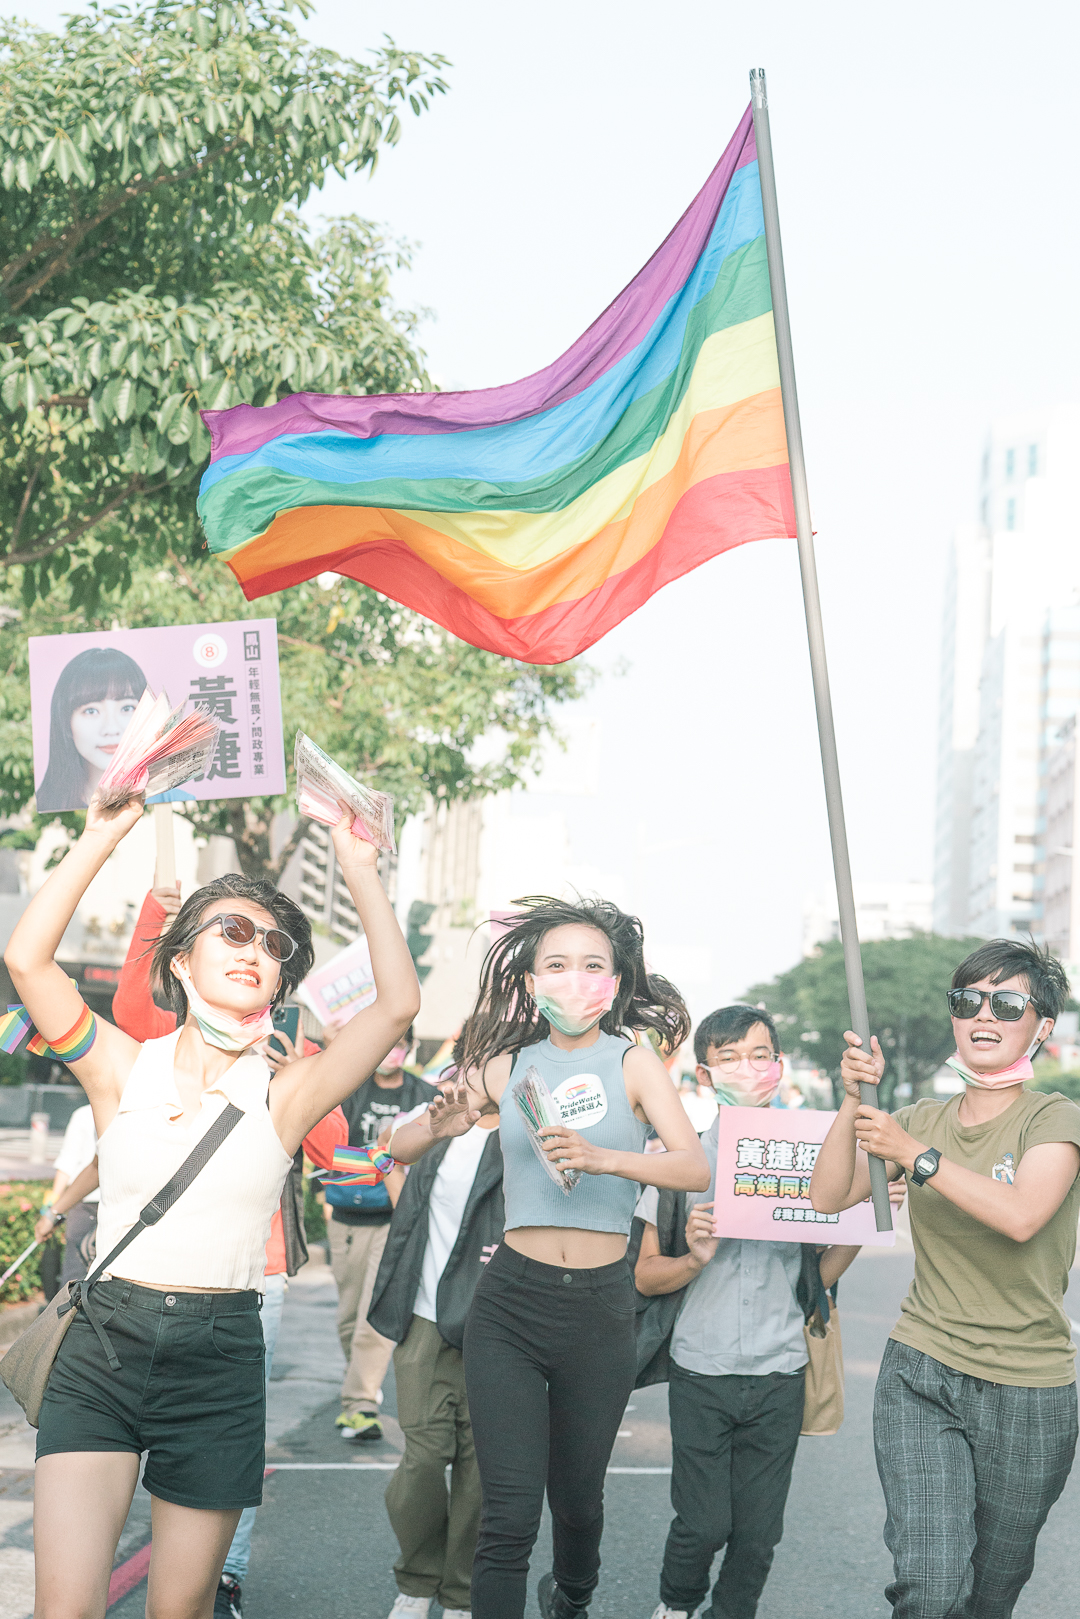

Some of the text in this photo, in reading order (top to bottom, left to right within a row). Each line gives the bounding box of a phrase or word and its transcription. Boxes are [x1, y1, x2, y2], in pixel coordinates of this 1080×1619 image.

[560, 1093, 601, 1110] PrideWatch
[560, 1100, 603, 1118] 友善候選人
